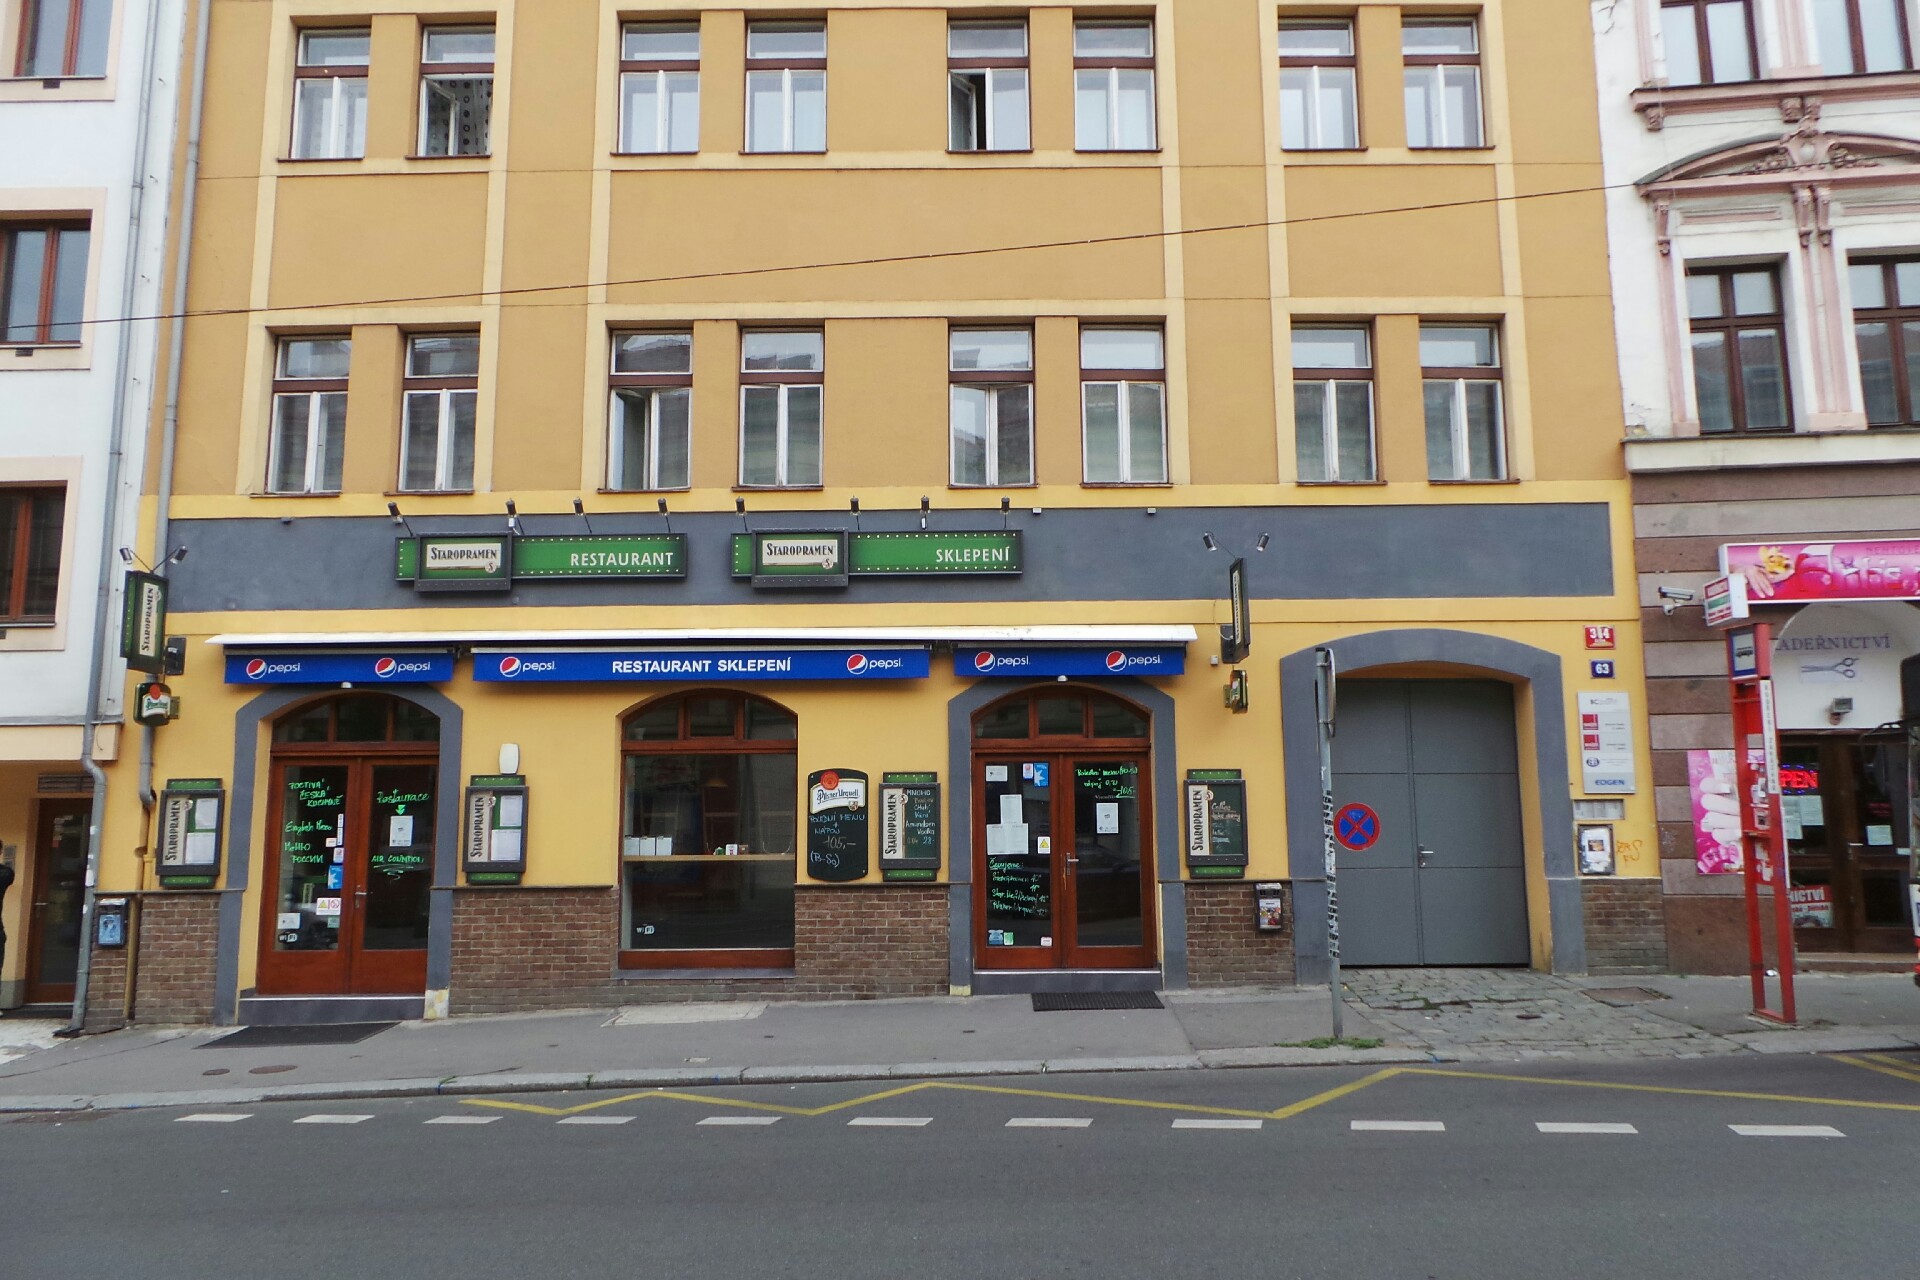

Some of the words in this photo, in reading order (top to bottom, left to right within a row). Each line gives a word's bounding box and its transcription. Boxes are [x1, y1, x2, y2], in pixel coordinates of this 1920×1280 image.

[430, 547, 498, 561] STAROPRAMEN
[766, 543, 834, 556] STAROPRAMEN
[936, 546, 1010, 562] SKLEPENÍ
[570, 552, 674, 566] RESTAURANT
[1776, 633, 1891, 650] ADEŘNICTVÍ
[522, 660, 556, 672] pepsi
[612, 660, 712, 674] RESTAURANT
[717, 657, 792, 673] SKLEPENÍ
[868, 658, 904, 670] pepsi
[997, 655, 1030, 667] pepsi
[1128, 654, 1162, 665] pepsi
[268, 662, 301, 674] pepsi
[397, 661, 431, 673] pepsi
[1596, 664, 1609, 674] 63
[1779, 770, 1819, 789] PEN
[470, 797, 485, 858] STAROPRAMEN
[885, 794, 897, 854] STAROPRAMEN
[1191, 790, 1204, 851] STAROPRAMEN
[165, 800, 180, 860] STAROPRAMEN
